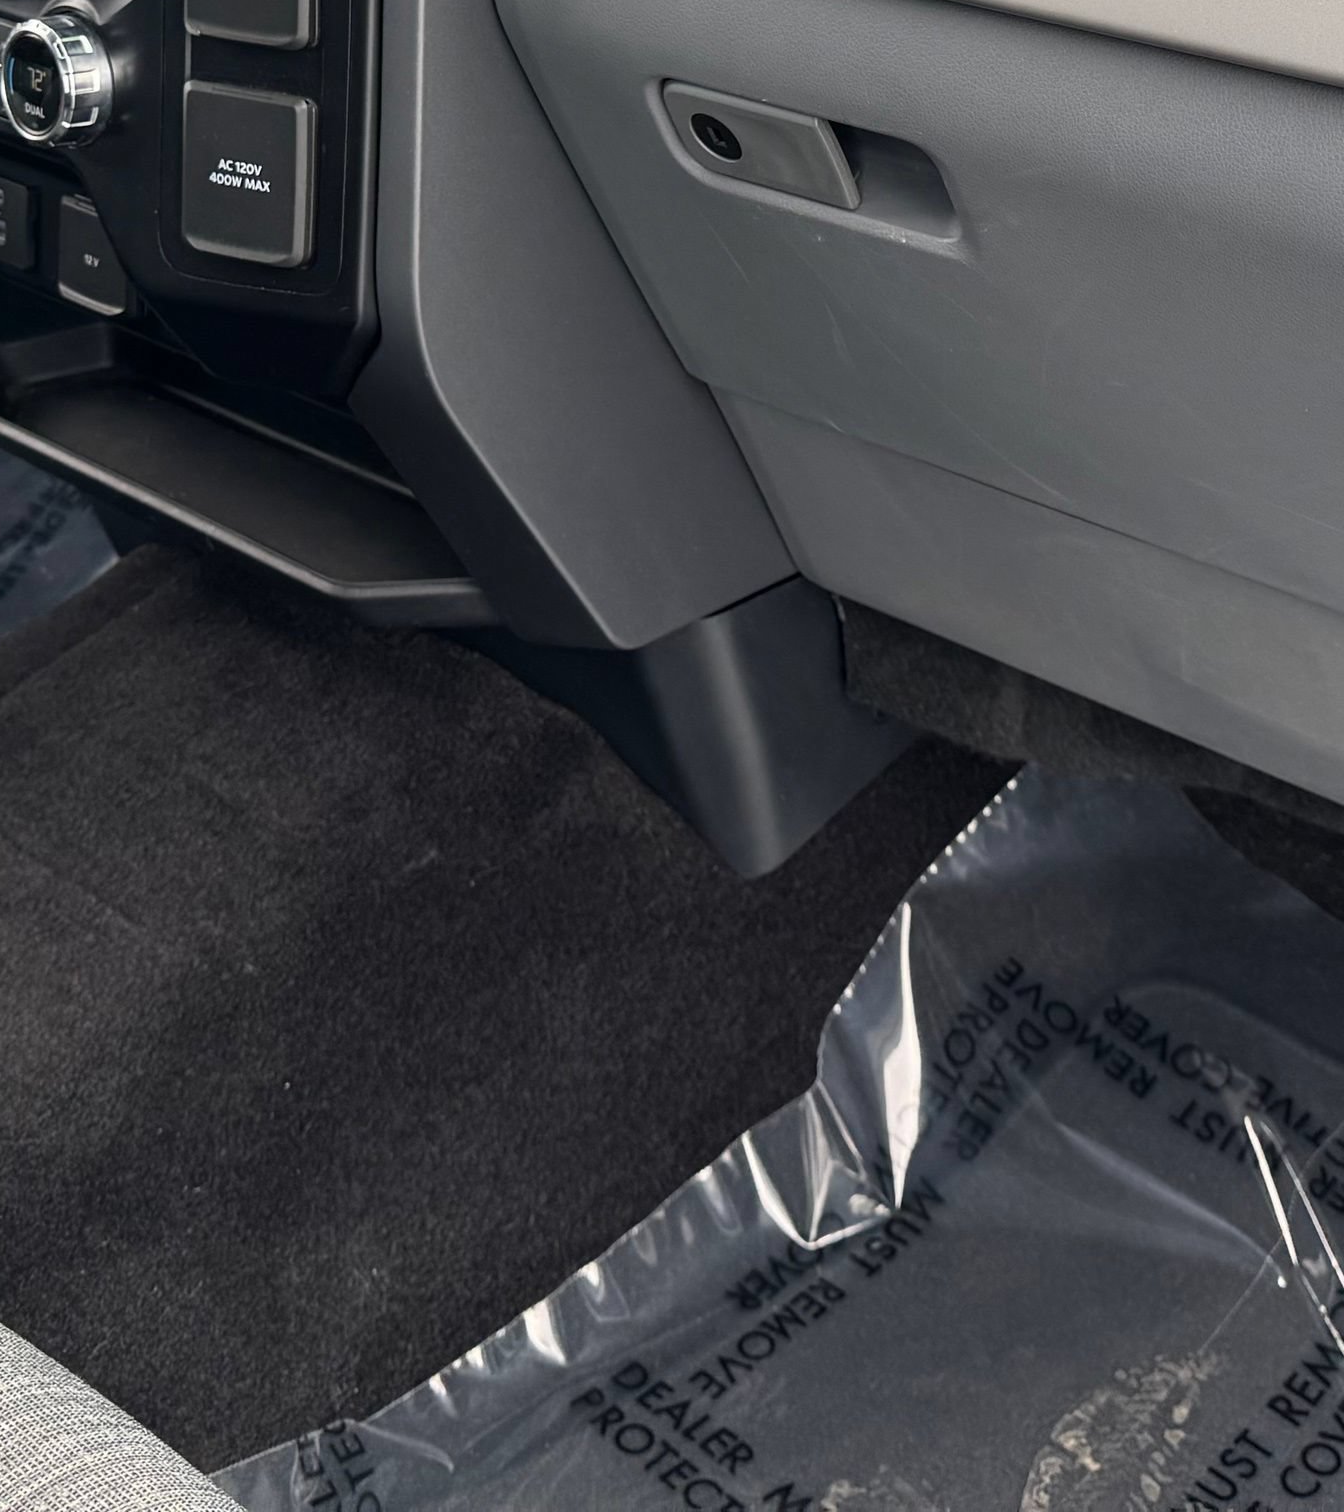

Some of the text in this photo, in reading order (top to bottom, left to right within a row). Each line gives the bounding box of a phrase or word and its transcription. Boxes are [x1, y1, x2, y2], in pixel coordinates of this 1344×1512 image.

[25, 101, 46, 119] DUAL
[217, 158, 263, 177] AC 120V
[208, 171, 271, 193] 400W MAX
[689, 1276, 847, 1399] REMOVE
[611, 1360, 755, 1476] DEALER
